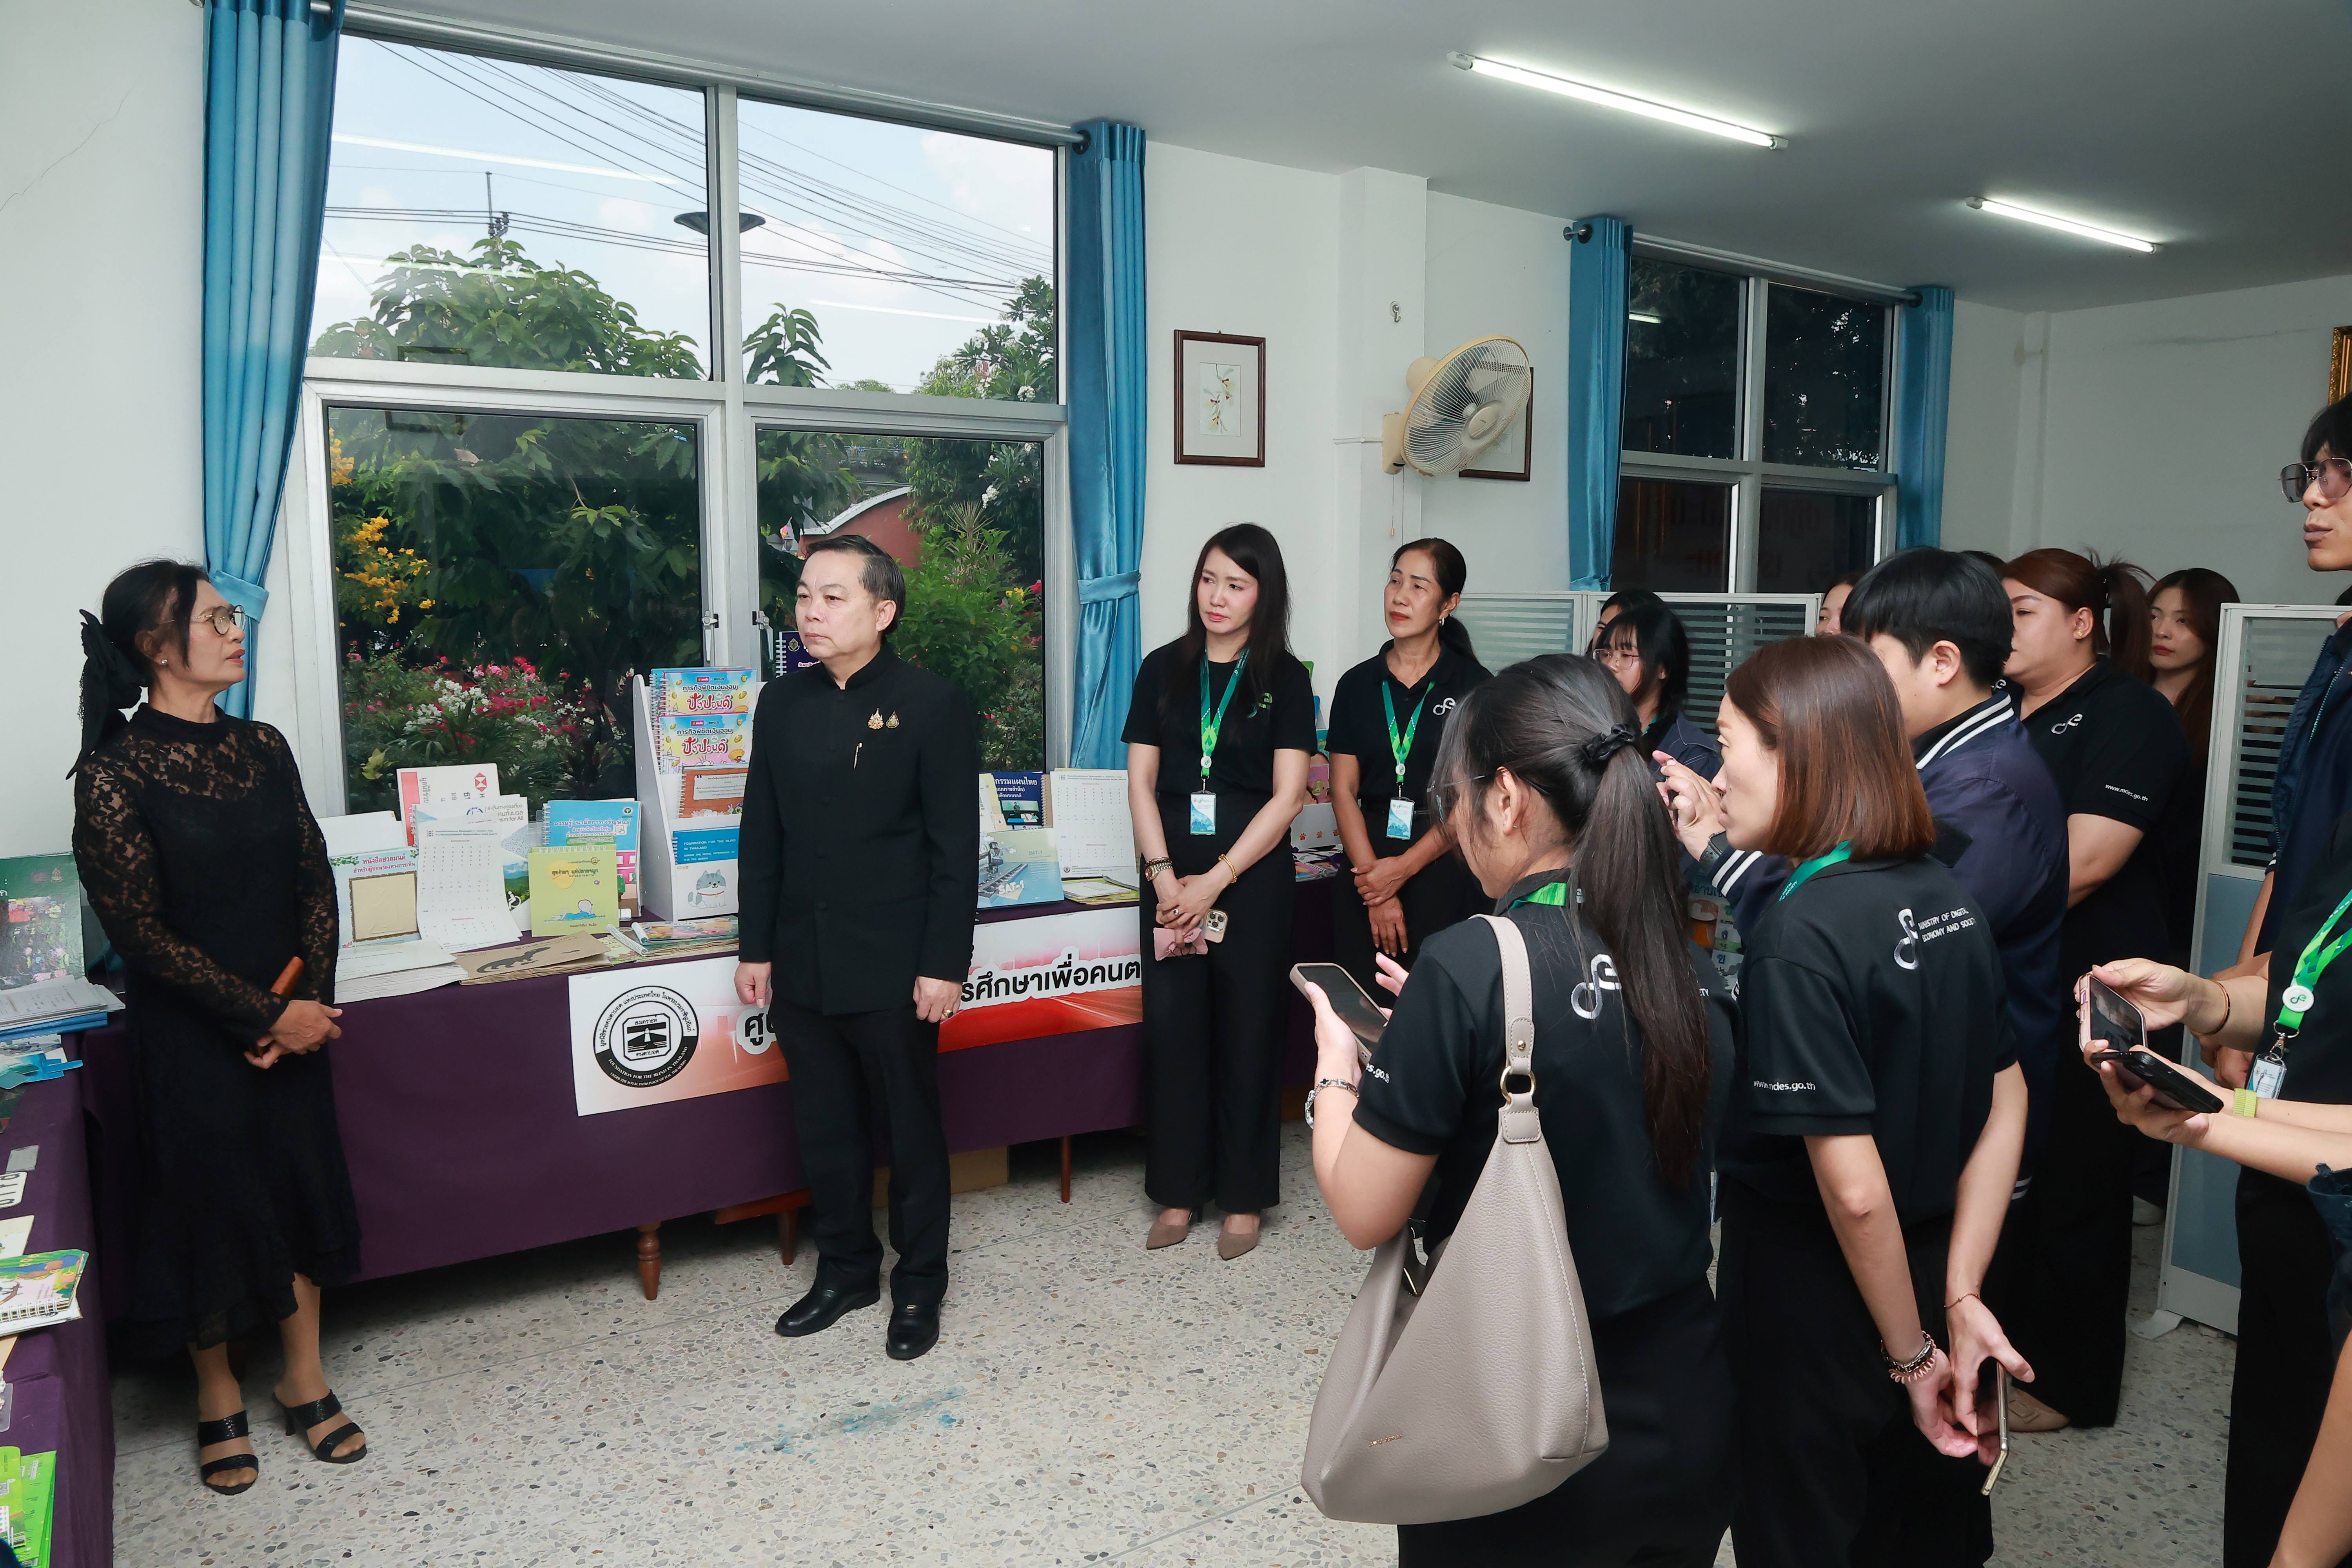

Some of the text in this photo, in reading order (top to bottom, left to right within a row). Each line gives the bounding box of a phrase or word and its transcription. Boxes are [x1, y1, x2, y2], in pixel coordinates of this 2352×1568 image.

[362, 853, 406, 864] หนังสือสวดมนต์
[998, 880, 1025, 895] SAT-1
[1941, 912, 1950, 921] OF
[1946, 922, 1960, 933] AND
[608, 1058, 632, 1078] FOUNDATION
[653, 1069, 667, 1078] BLIND
[671, 1046, 688, 1068] THAILAND
